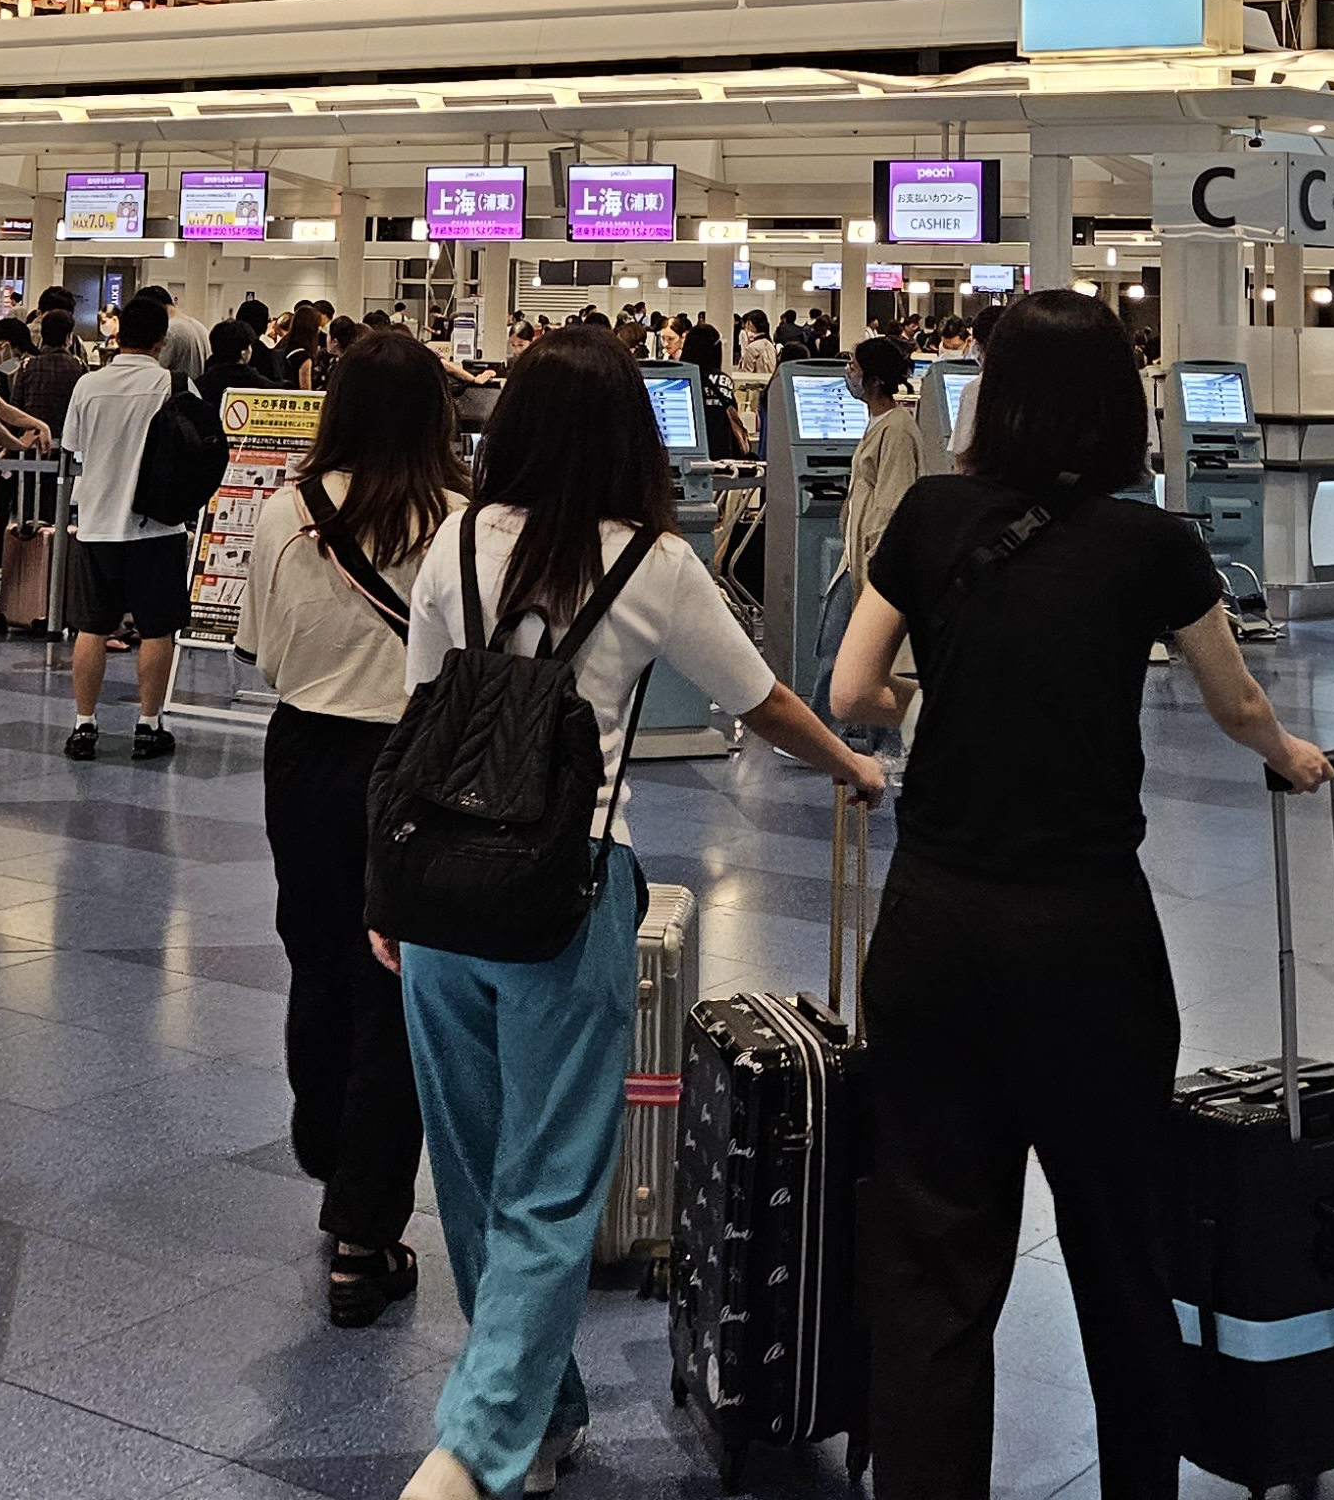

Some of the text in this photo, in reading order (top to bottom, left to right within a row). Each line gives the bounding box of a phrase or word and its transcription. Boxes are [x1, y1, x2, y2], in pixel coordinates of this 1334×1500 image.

[917, 166, 954, 180] peach
[897, 193, 972, 204] お支払いカウンター
[1192, 167, 1235, 228] C
[1300, 170, 1326, 231] C
[910, 218, 961, 230] CASHIER
[111, 285, 119, 305] EXIT
